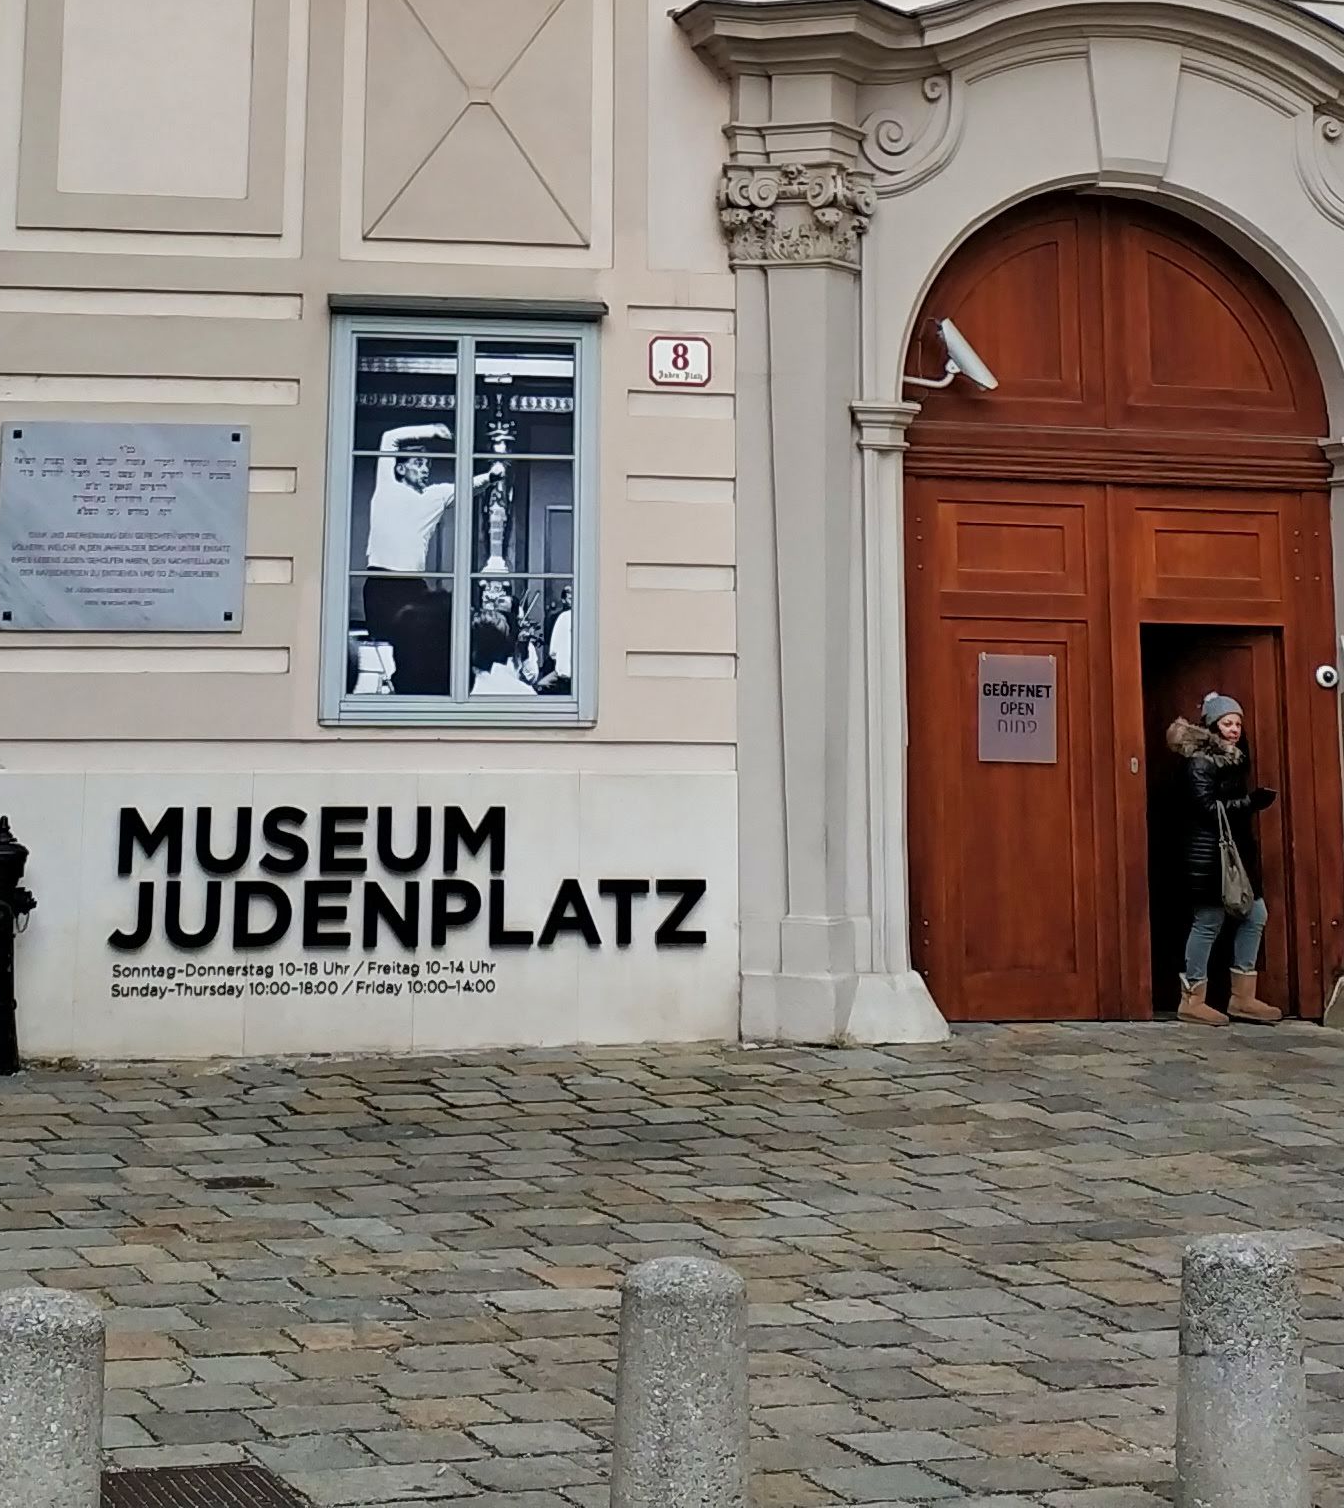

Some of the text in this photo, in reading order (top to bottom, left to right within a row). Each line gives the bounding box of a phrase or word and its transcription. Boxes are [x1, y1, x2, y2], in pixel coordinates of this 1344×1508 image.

[671, 342, 690, 371] 8
[982, 680, 1052, 698] GEÖFFNET
[1000, 701, 1035, 716] OPEN
[117, 805, 507, 875] MUSEUM
[107, 877, 708, 950] JUDENPLATZ
[111, 962, 274, 980] Sonntag-Donnerstag
[279, 961, 318, 977] 10-18
[323, 961, 350, 976] Uhr
[367, 960, 420, 978] Freitag
[425, 960, 464, 975] 10-14
[469, 960, 497, 975] Uhr
[111, 982, 244, 1000] Sunday-Thursday
[249, 980, 339, 996] 10:00-18:00
[355, 979, 403, 997] Friday
[407, 979, 497, 995] 10:00-14:00
